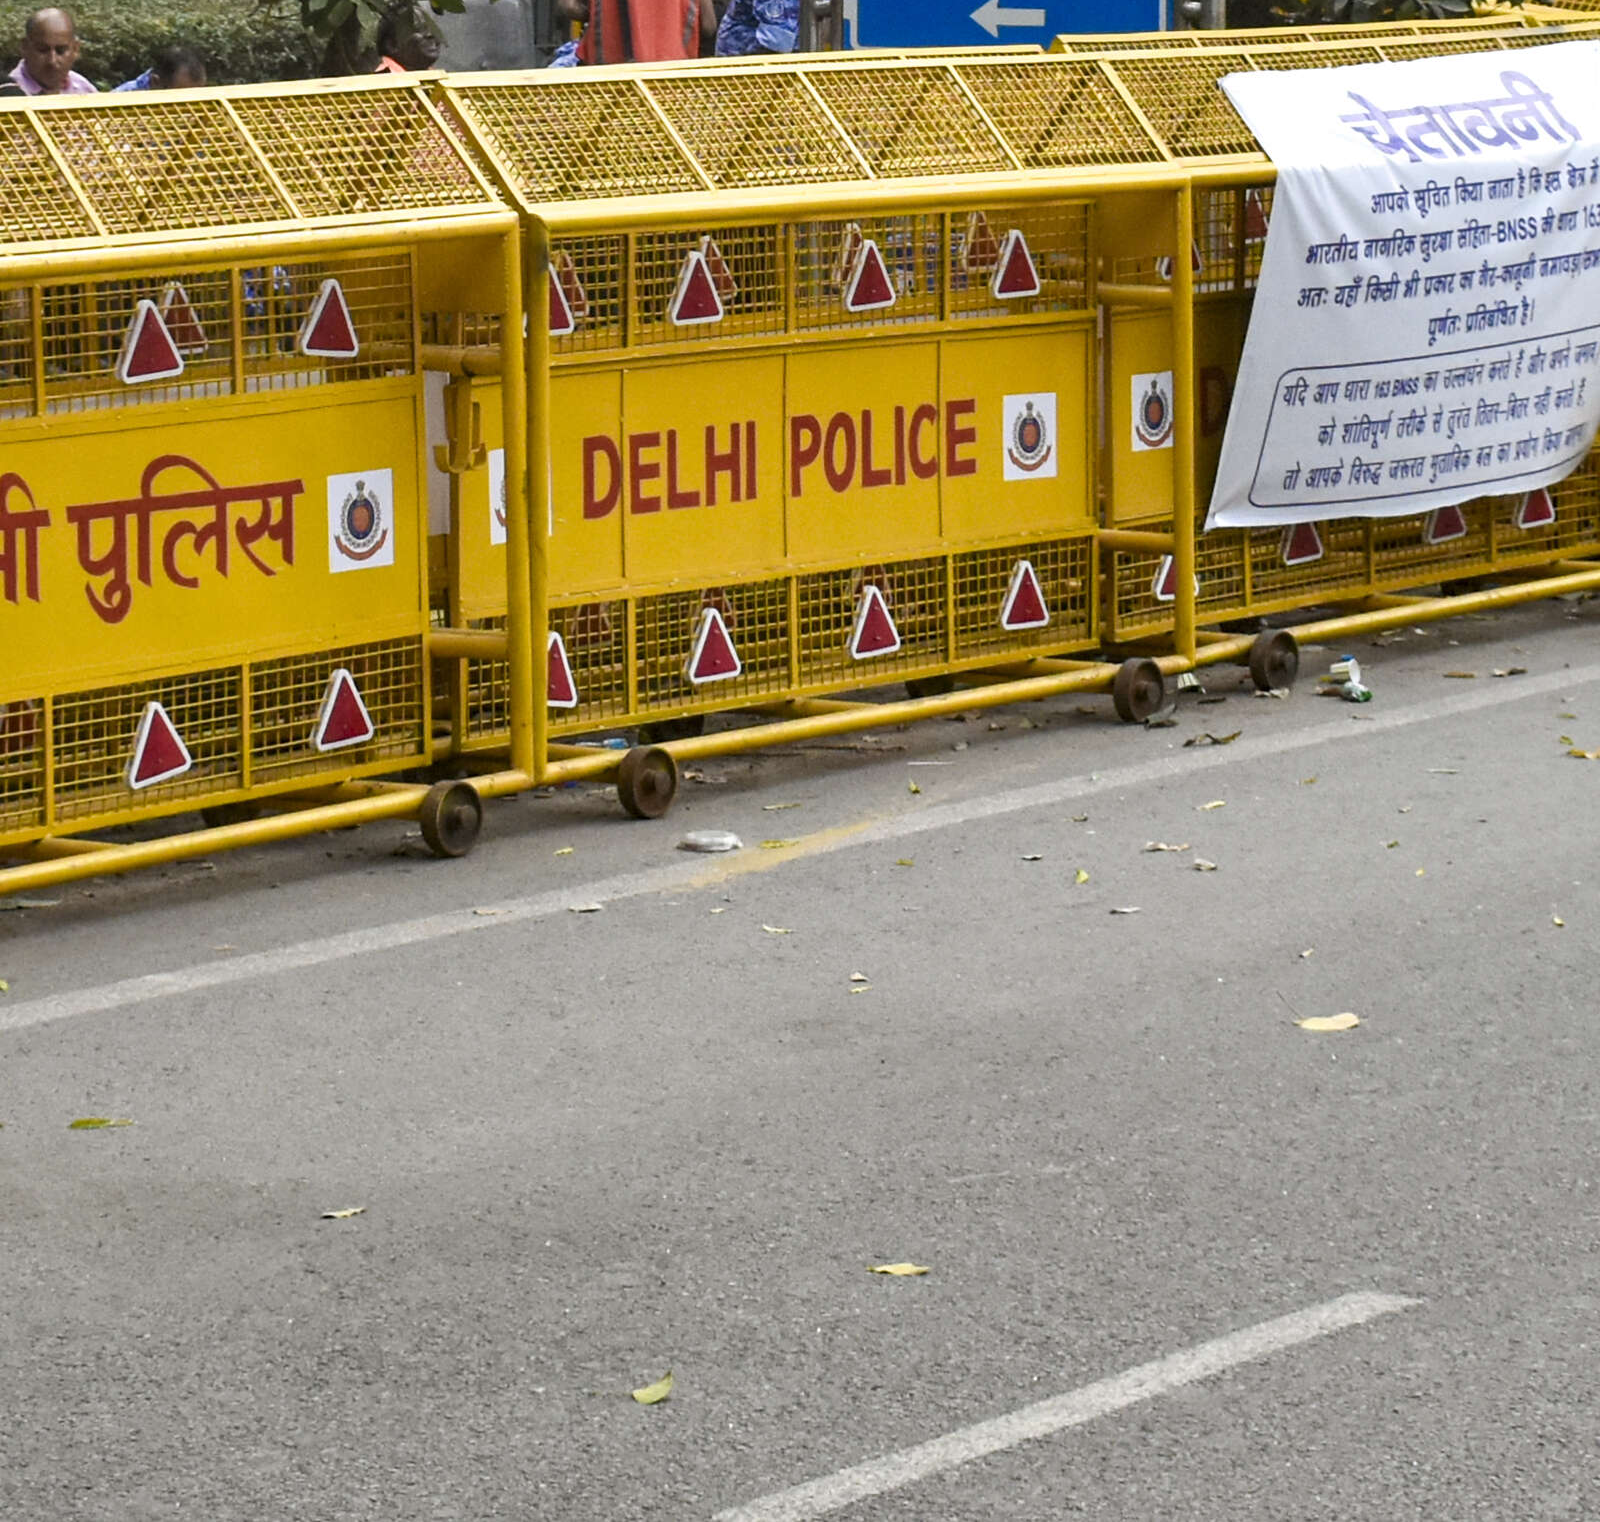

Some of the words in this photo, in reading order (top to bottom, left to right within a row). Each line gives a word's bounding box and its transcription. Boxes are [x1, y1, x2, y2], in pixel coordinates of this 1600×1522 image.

[1340, 70, 1581, 162] चेतावनी
[1371, 184, 1410, 214] आपको
[1413, 180, 1451, 218] सूचित
[1455, 176, 1484, 204] किया
[1487, 177, 1515, 200] जाता
[1528, 166, 1542, 195] कि
[1566, 162, 1586, 189] क्षेत्र
[1305, 233, 1359, 264] भारतीय
[1363, 228, 1417, 259] नागरिक
[1419, 230, 1454, 263] सुरक्षा
[1541, 206, 1555, 234] की
[1557, 210, 1579, 231] धारा
[1333, 275, 1363, 308] यहाँ
[1364, 272, 1401, 303] किसी
[1402, 269, 1420, 299] भी
[1423, 273, 1456, 297] प्रकार
[1459, 270, 1475, 291] का
[1465, 298, 1519, 333] प्रतिबंधित
[1282, 376, 1309, 407] यदि
[1313, 382, 1340, 404] आप
[1343, 379, 1372, 402] धारा
[1374, 380, 1391, 399] 163
[1391, 376, 1420, 398] BNSS
[1423, 370, 1440, 393] का
[1317, 416, 1337, 447] को
[1342, 409, 1395, 450] शांतिपूर्ण
[1396, 405, 1428, 439] तरीके
[1432, 404, 1444, 434] से
[583, 420, 758, 520] DELHI
[790, 398, 977, 498] POLICE
[1282, 460, 1301, 491] तो
[1305, 457, 1345, 491] आपके
[1348, 455, 1384, 486] विरुद्ध
[1429, 442, 1473, 485] मुताबिक
[1497, 441, 1512, 463] का
[65, 454, 305, 624] पुलिस
